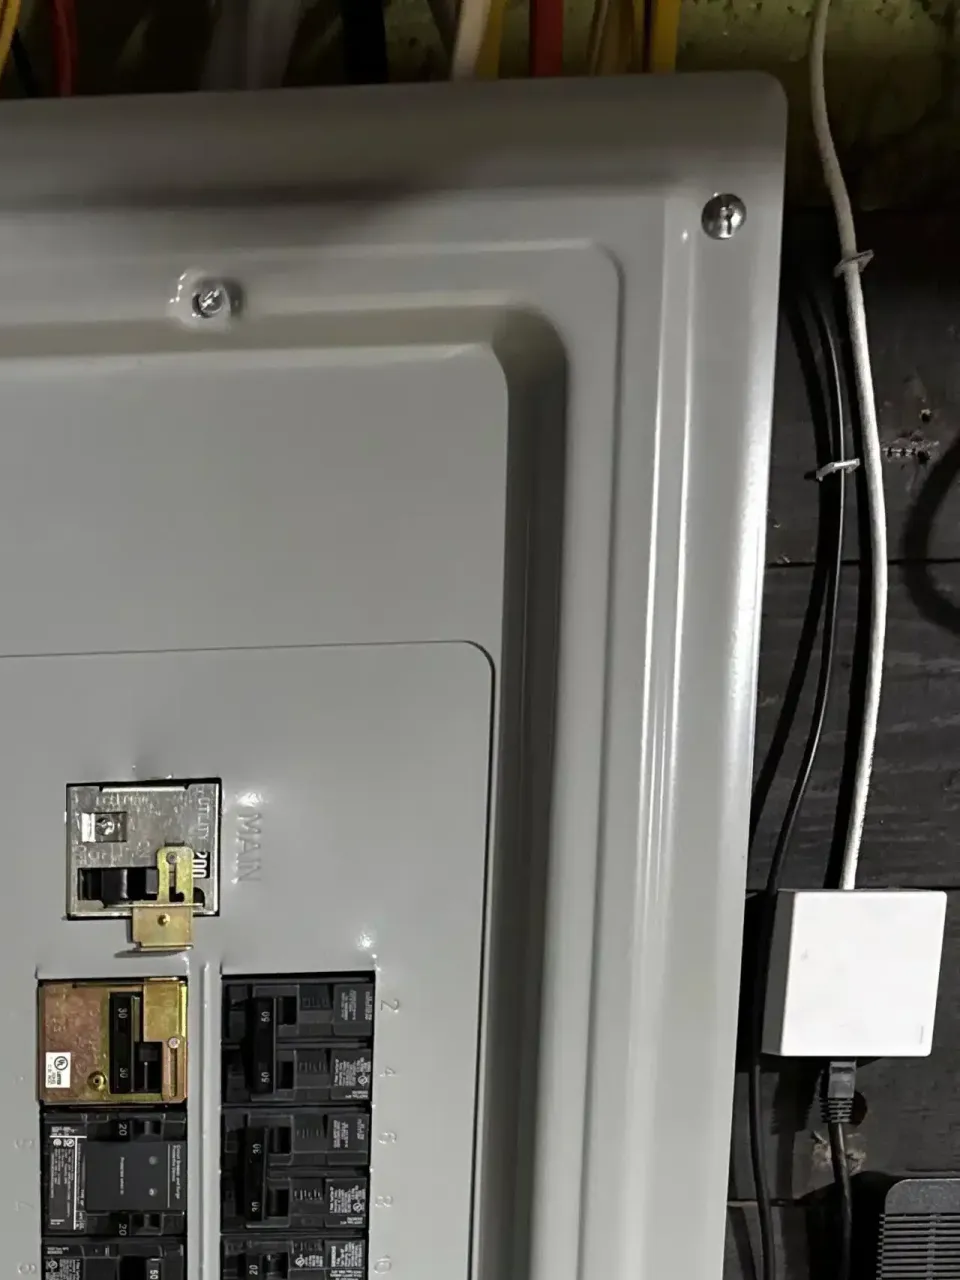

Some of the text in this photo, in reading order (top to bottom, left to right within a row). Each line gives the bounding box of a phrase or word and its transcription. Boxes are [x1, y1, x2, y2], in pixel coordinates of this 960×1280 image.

[198, 797, 210, 841] UTILITY
[237, 807, 263, 884] MAIN
[193, 851, 207, 878] 200
[380, 999, 400, 1013] 2
[117, 1006, 126, 1019] 30
[262, 1011, 270, 1022] 50
[118, 1067, 126, 1079] 30
[261, 1071, 269, 1083] 50
[380, 1067, 396, 1079] 4
[119, 1123, 128, 1136] 20
[252, 1143, 261, 1154] 30
[252, 1201, 260, 1212] 30
[119, 1224, 128, 1236] 20
[249, 1264, 258, 1275] 20
[374, 1256, 392, 1274] 10
[150, 1270, 158, 1280] 50
